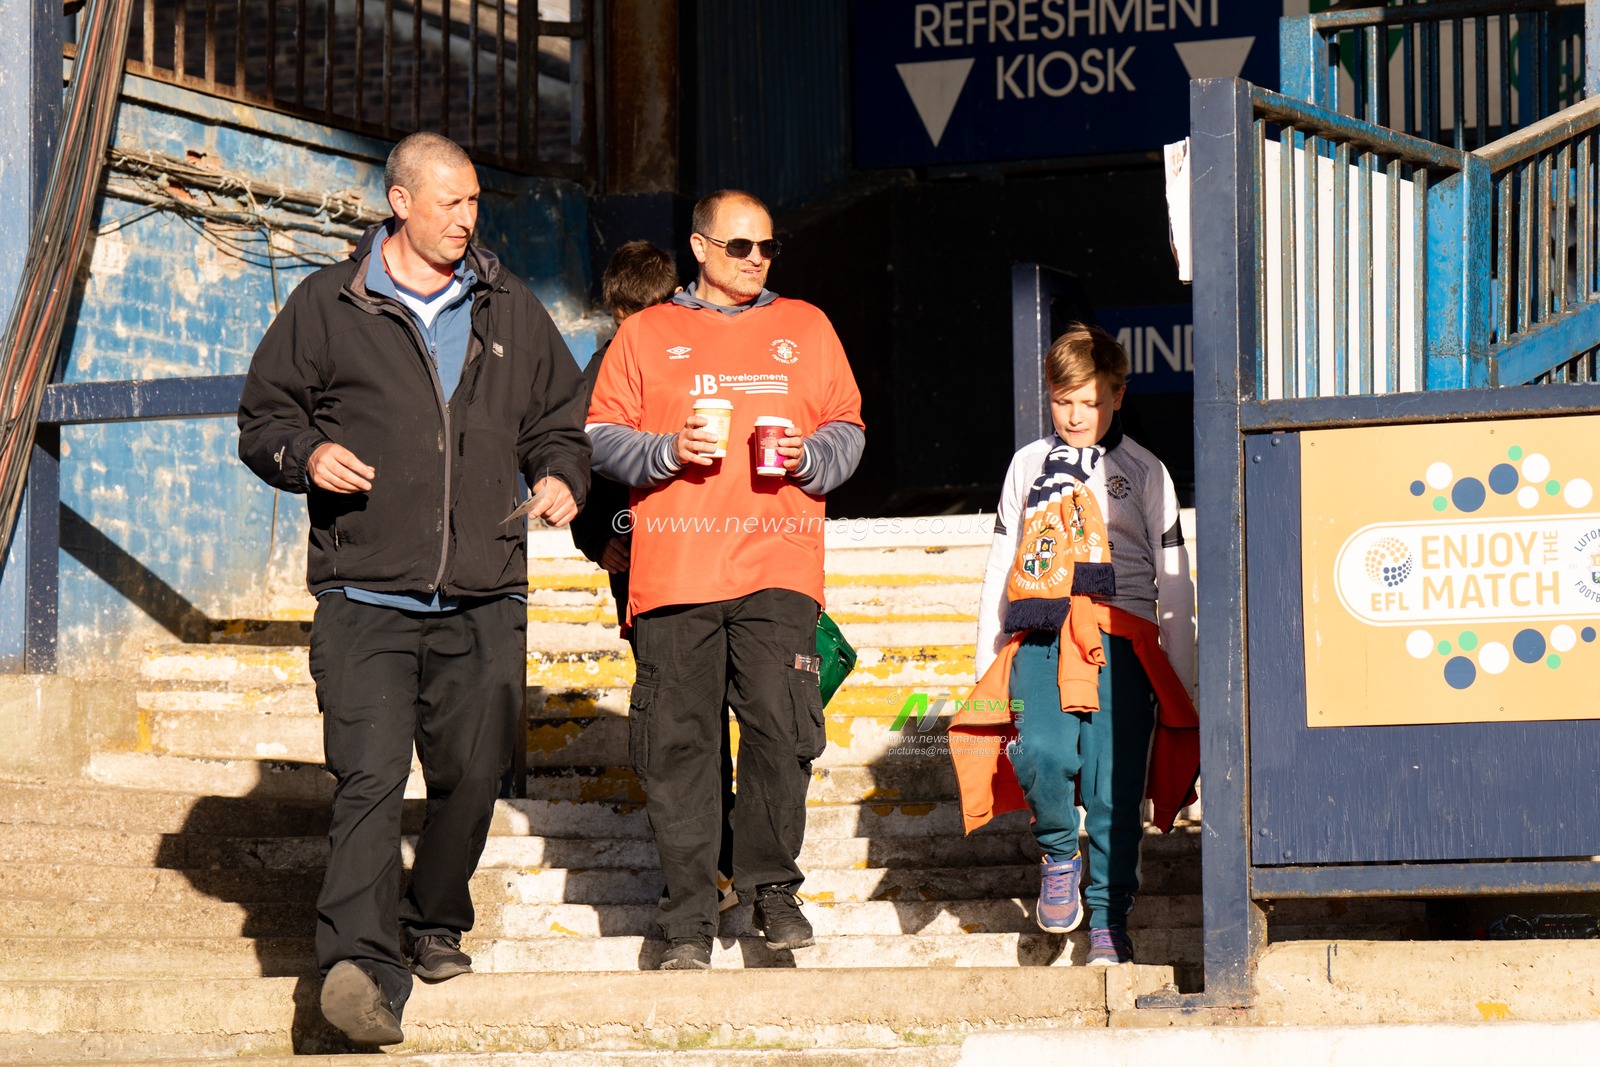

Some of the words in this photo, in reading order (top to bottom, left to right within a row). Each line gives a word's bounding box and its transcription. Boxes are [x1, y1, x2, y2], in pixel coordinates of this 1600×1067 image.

[915, 0, 1221, 49] REFRESHMENT
[996, 46, 1137, 101] KIOSK
[689, 374, 719, 397] JB
[719, 374, 788, 382] Developments
[1082, 531, 1101, 553] CLUB
[1421, 530, 1539, 571] ENJOY
[1542, 530, 1560, 566] THE
[1013, 571, 1047, 591] FOOTBALL
[1047, 566, 1068, 588] CLUB
[1421, 571, 1561, 611] MATCH
[1370, 591, 1410, 613] EFL
